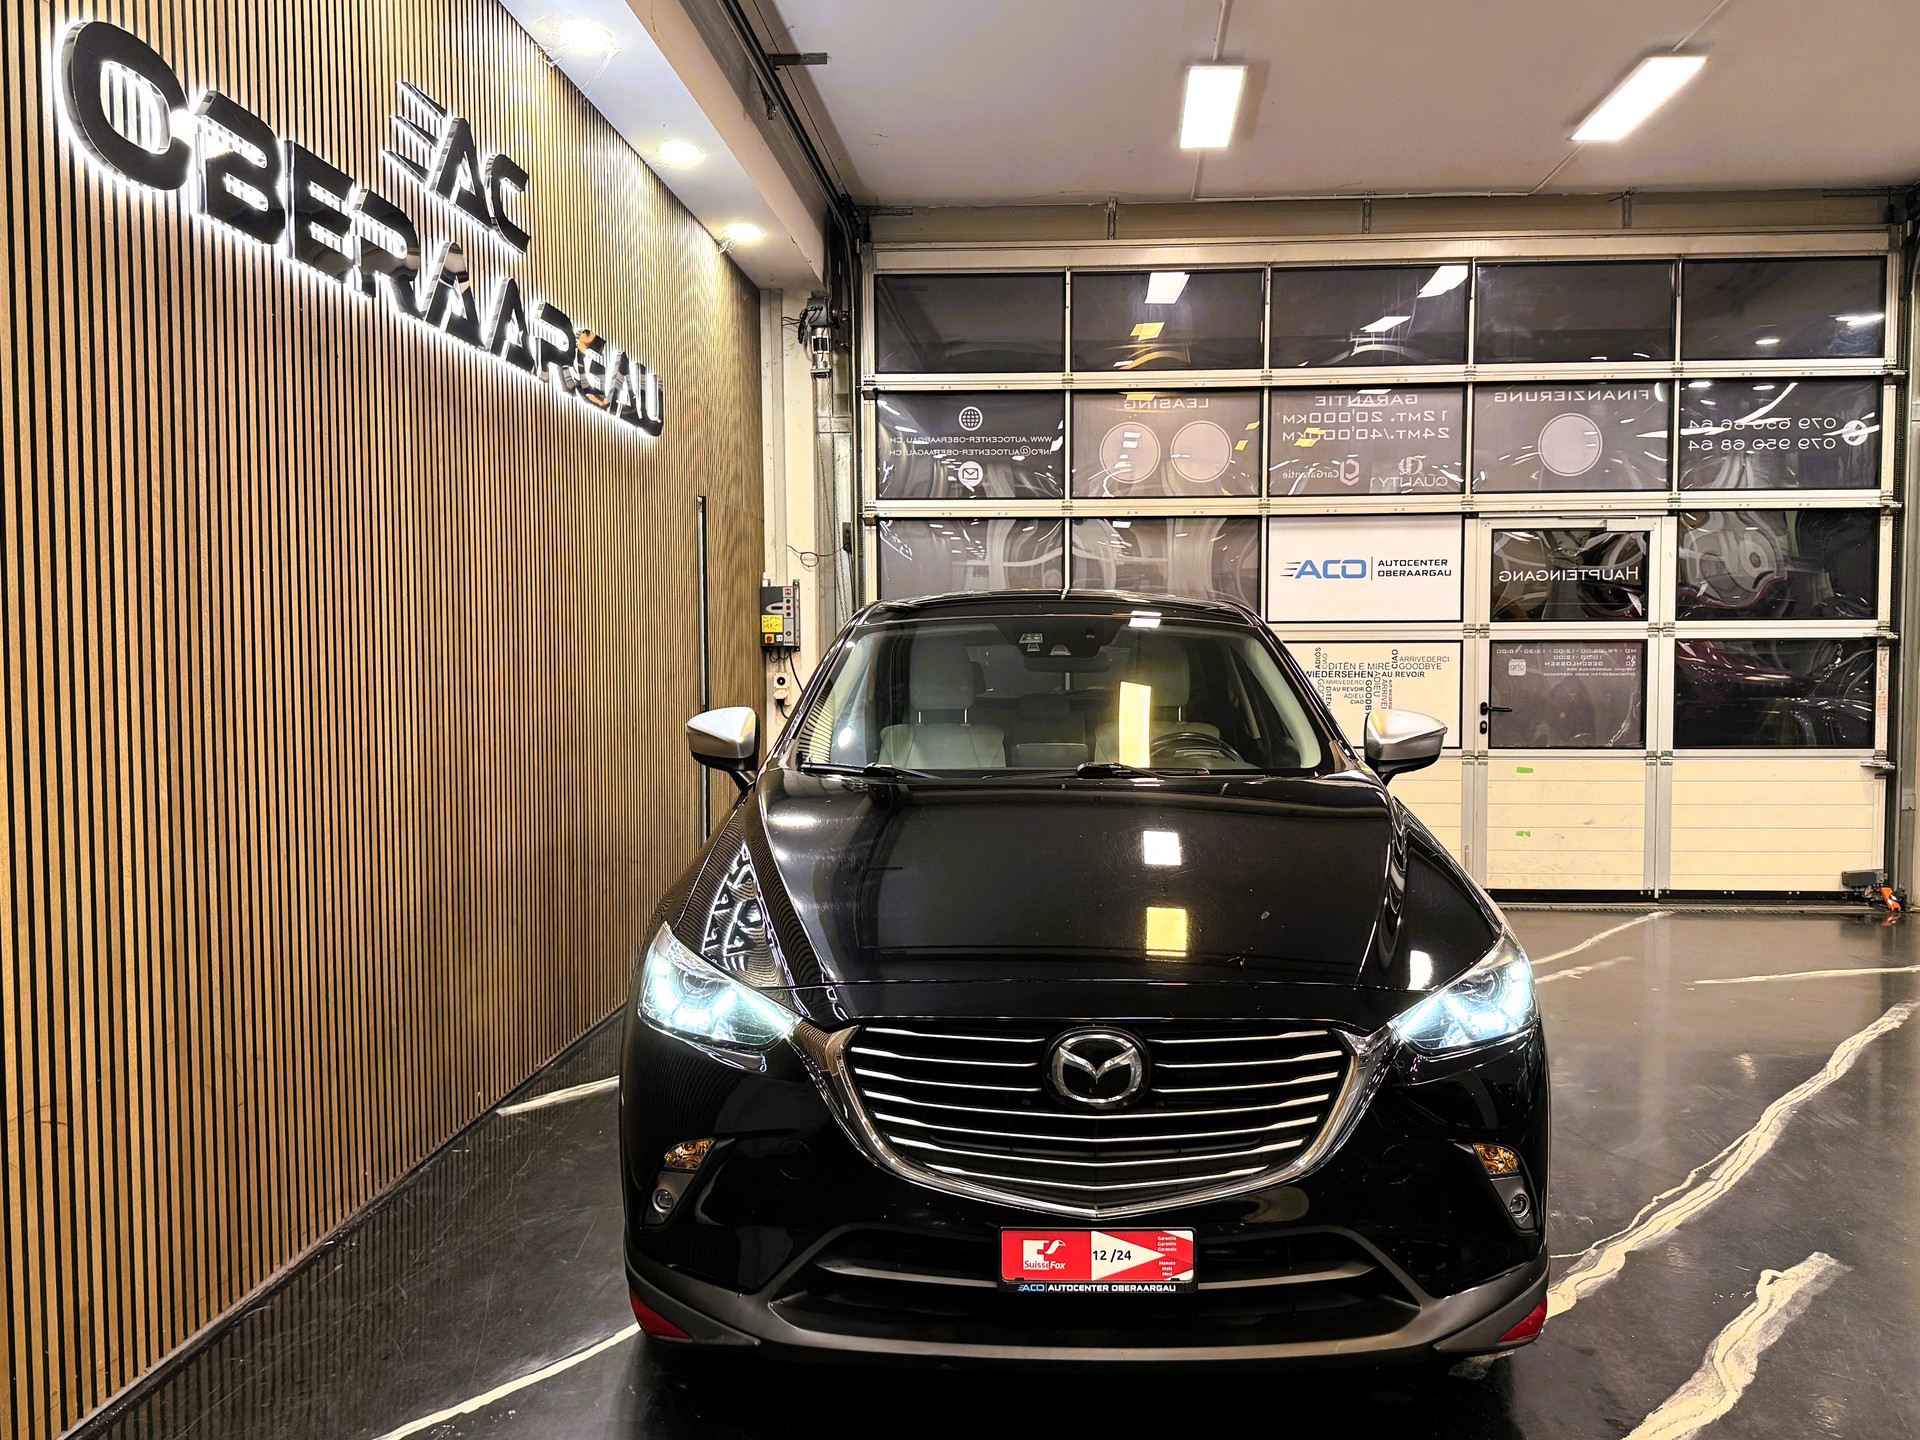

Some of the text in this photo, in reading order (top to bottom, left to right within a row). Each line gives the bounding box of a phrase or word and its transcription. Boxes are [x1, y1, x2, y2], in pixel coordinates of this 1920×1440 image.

[58, 20, 665, 437] OBERAARGAU
[1377, 559, 1448, 567] AUTOCENTER
[1294, 560, 1367, 579] ACO
[1377, 569, 1452, 577] OBERAARGAU
[1358, 662, 1365, 670] E
[1304, 670, 1374, 678] WIEDERSEHEN
[1092, 1249, 1132, 1263] 12 /24
[1048, 1284, 1109, 1292] AUTOCENTER
[1112, 1284, 1176, 1292] OBERAARGAU
